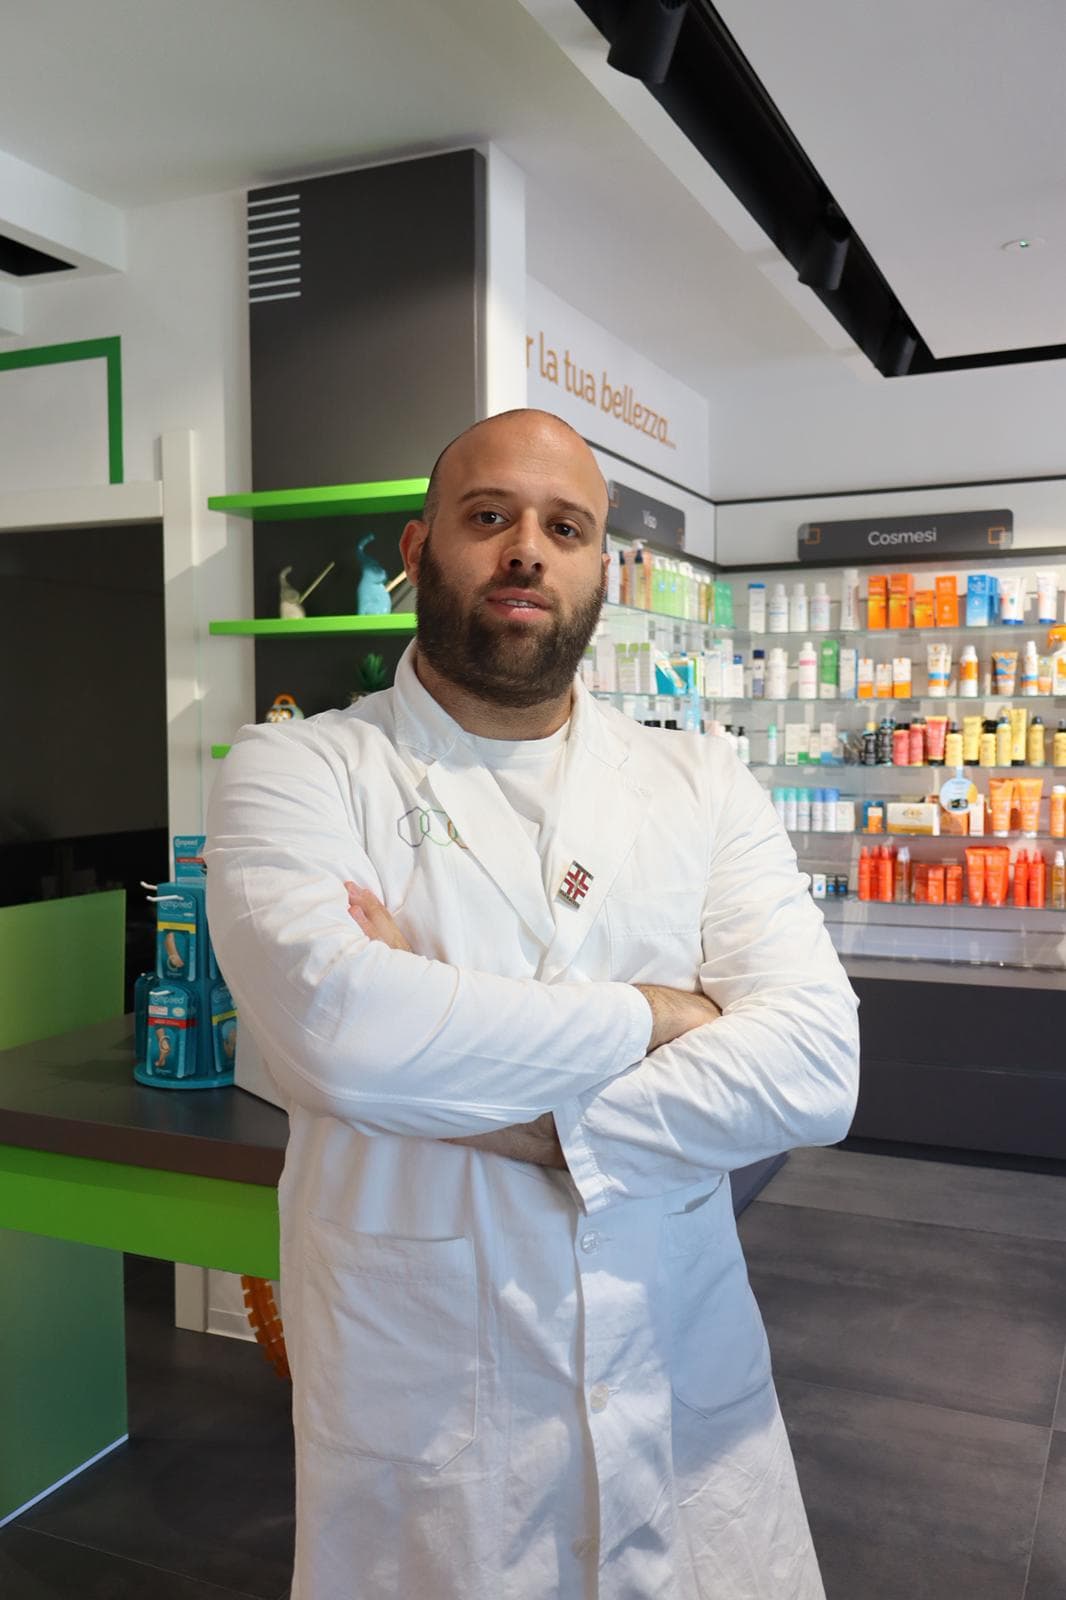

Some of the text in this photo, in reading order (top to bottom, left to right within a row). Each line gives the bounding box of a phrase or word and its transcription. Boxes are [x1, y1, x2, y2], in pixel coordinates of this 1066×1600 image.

[540, 331, 558, 385] la
[564, 350, 596, 406] tua
[868, 527, 937, 546] Cosmesi
